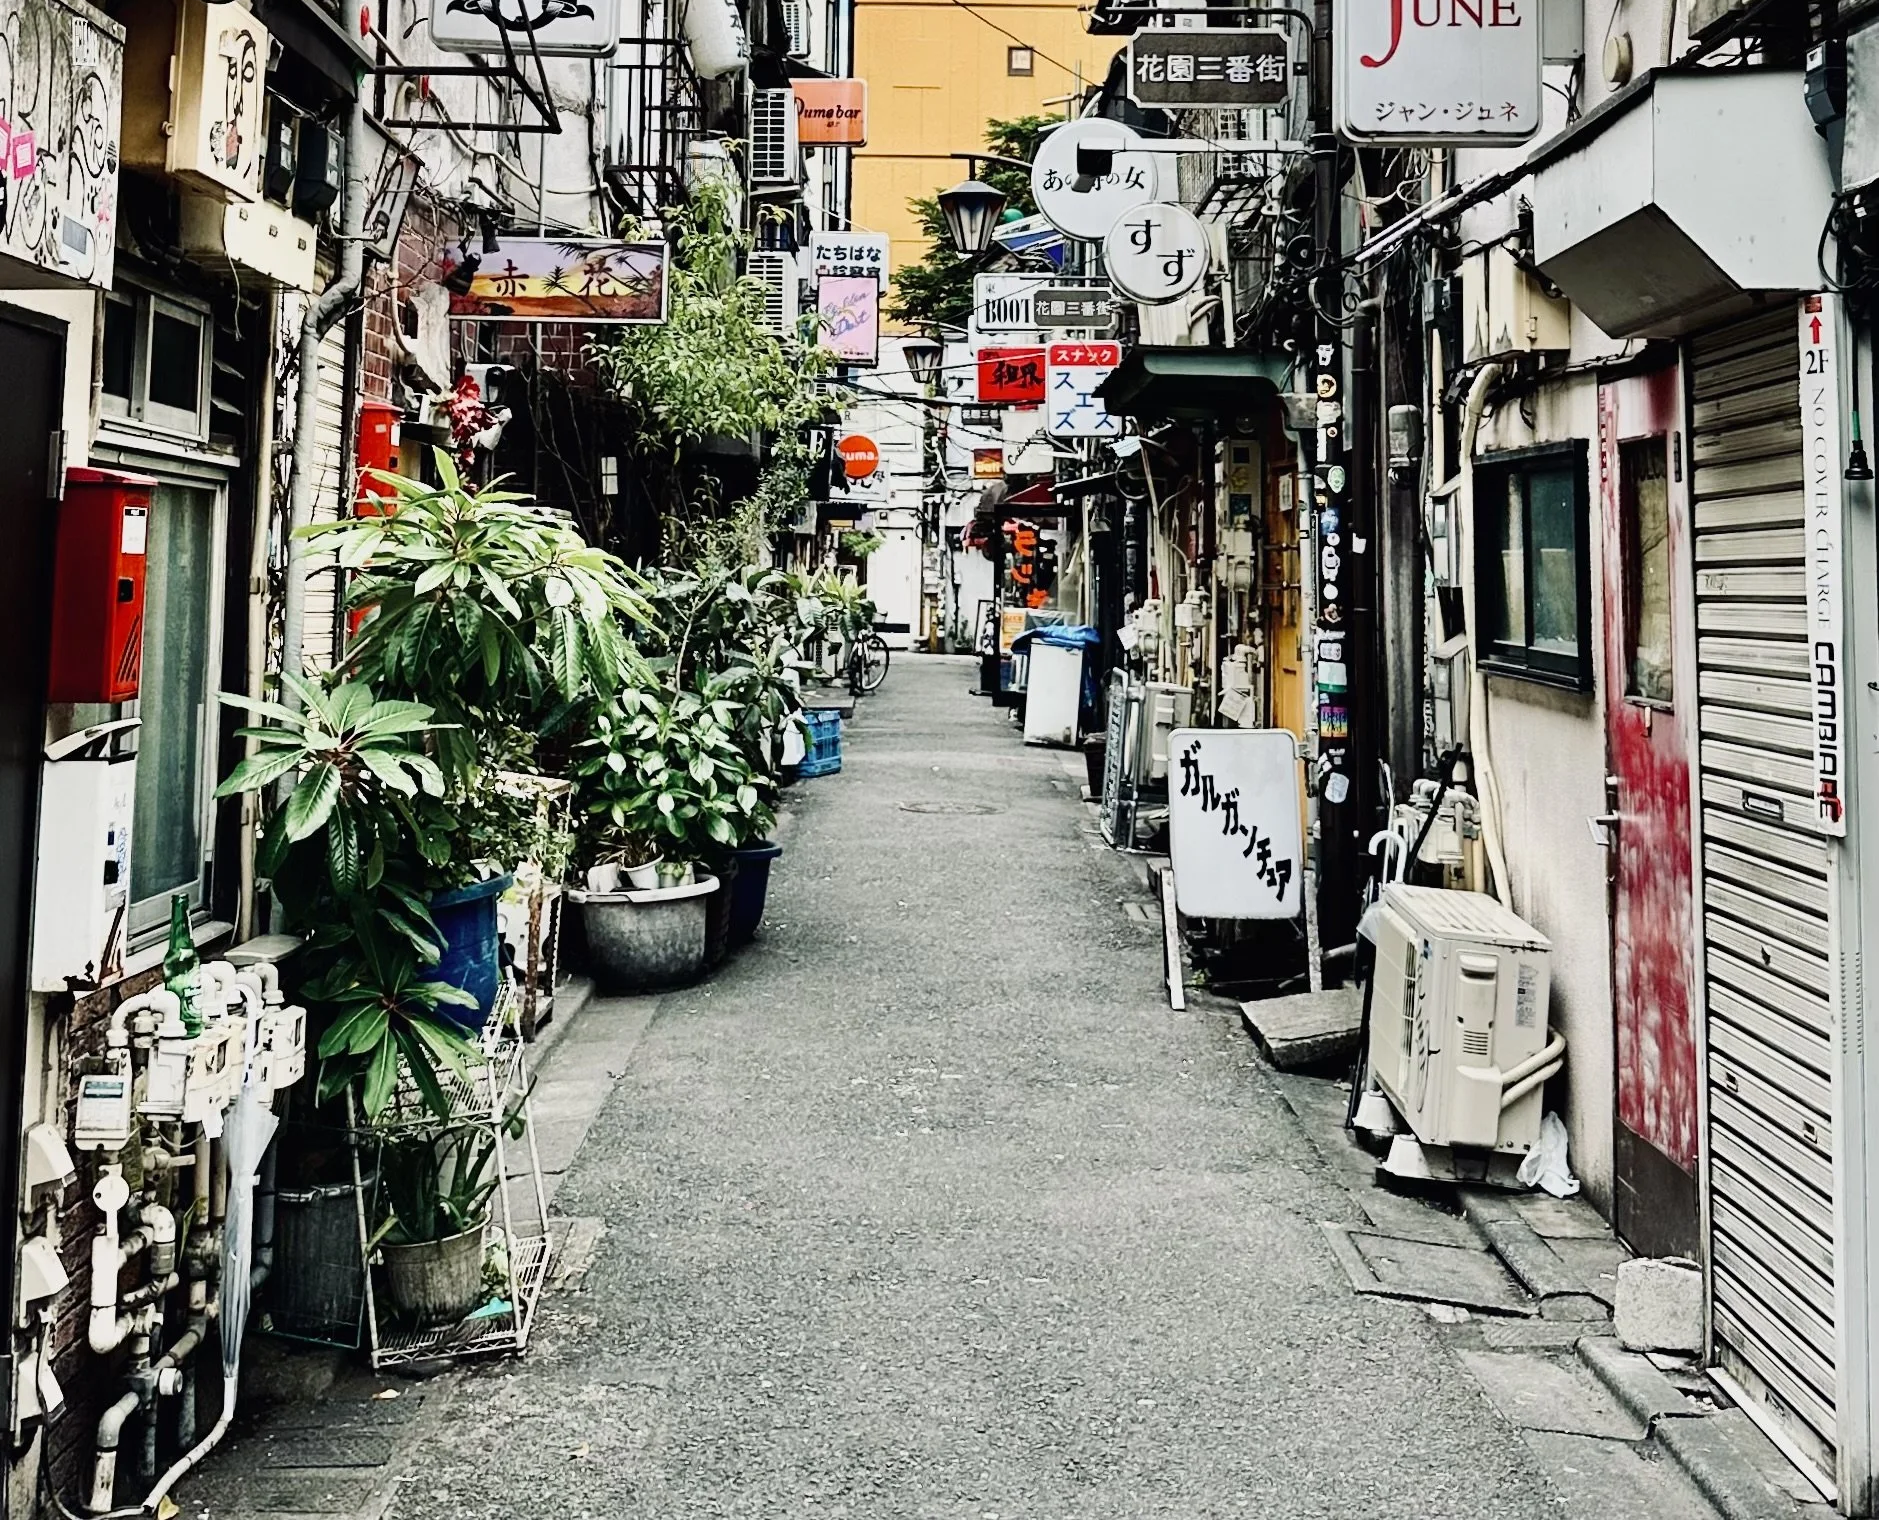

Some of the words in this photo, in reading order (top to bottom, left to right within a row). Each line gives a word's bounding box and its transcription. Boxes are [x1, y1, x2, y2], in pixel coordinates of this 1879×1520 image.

[1136, 53, 1286, 83] 花園三番街
[1376, 101, 1519, 123] ジャン・ジュネ
[816, 244, 881, 263] たちばな
[1124, 219, 1197, 286] すず
[985, 298, 1031, 323] BOOT
[1036, 300, 1112, 317] 花園三番街
[1057, 350, 1112, 362] スナック
[1805, 348, 1829, 375] 2F
[1811, 387, 1826, 427] NO
[1813, 437, 1829, 518] COVER
[1815, 528, 1832, 630] CHARGE
[1180, 739, 1292, 902] ガルガンチュア
